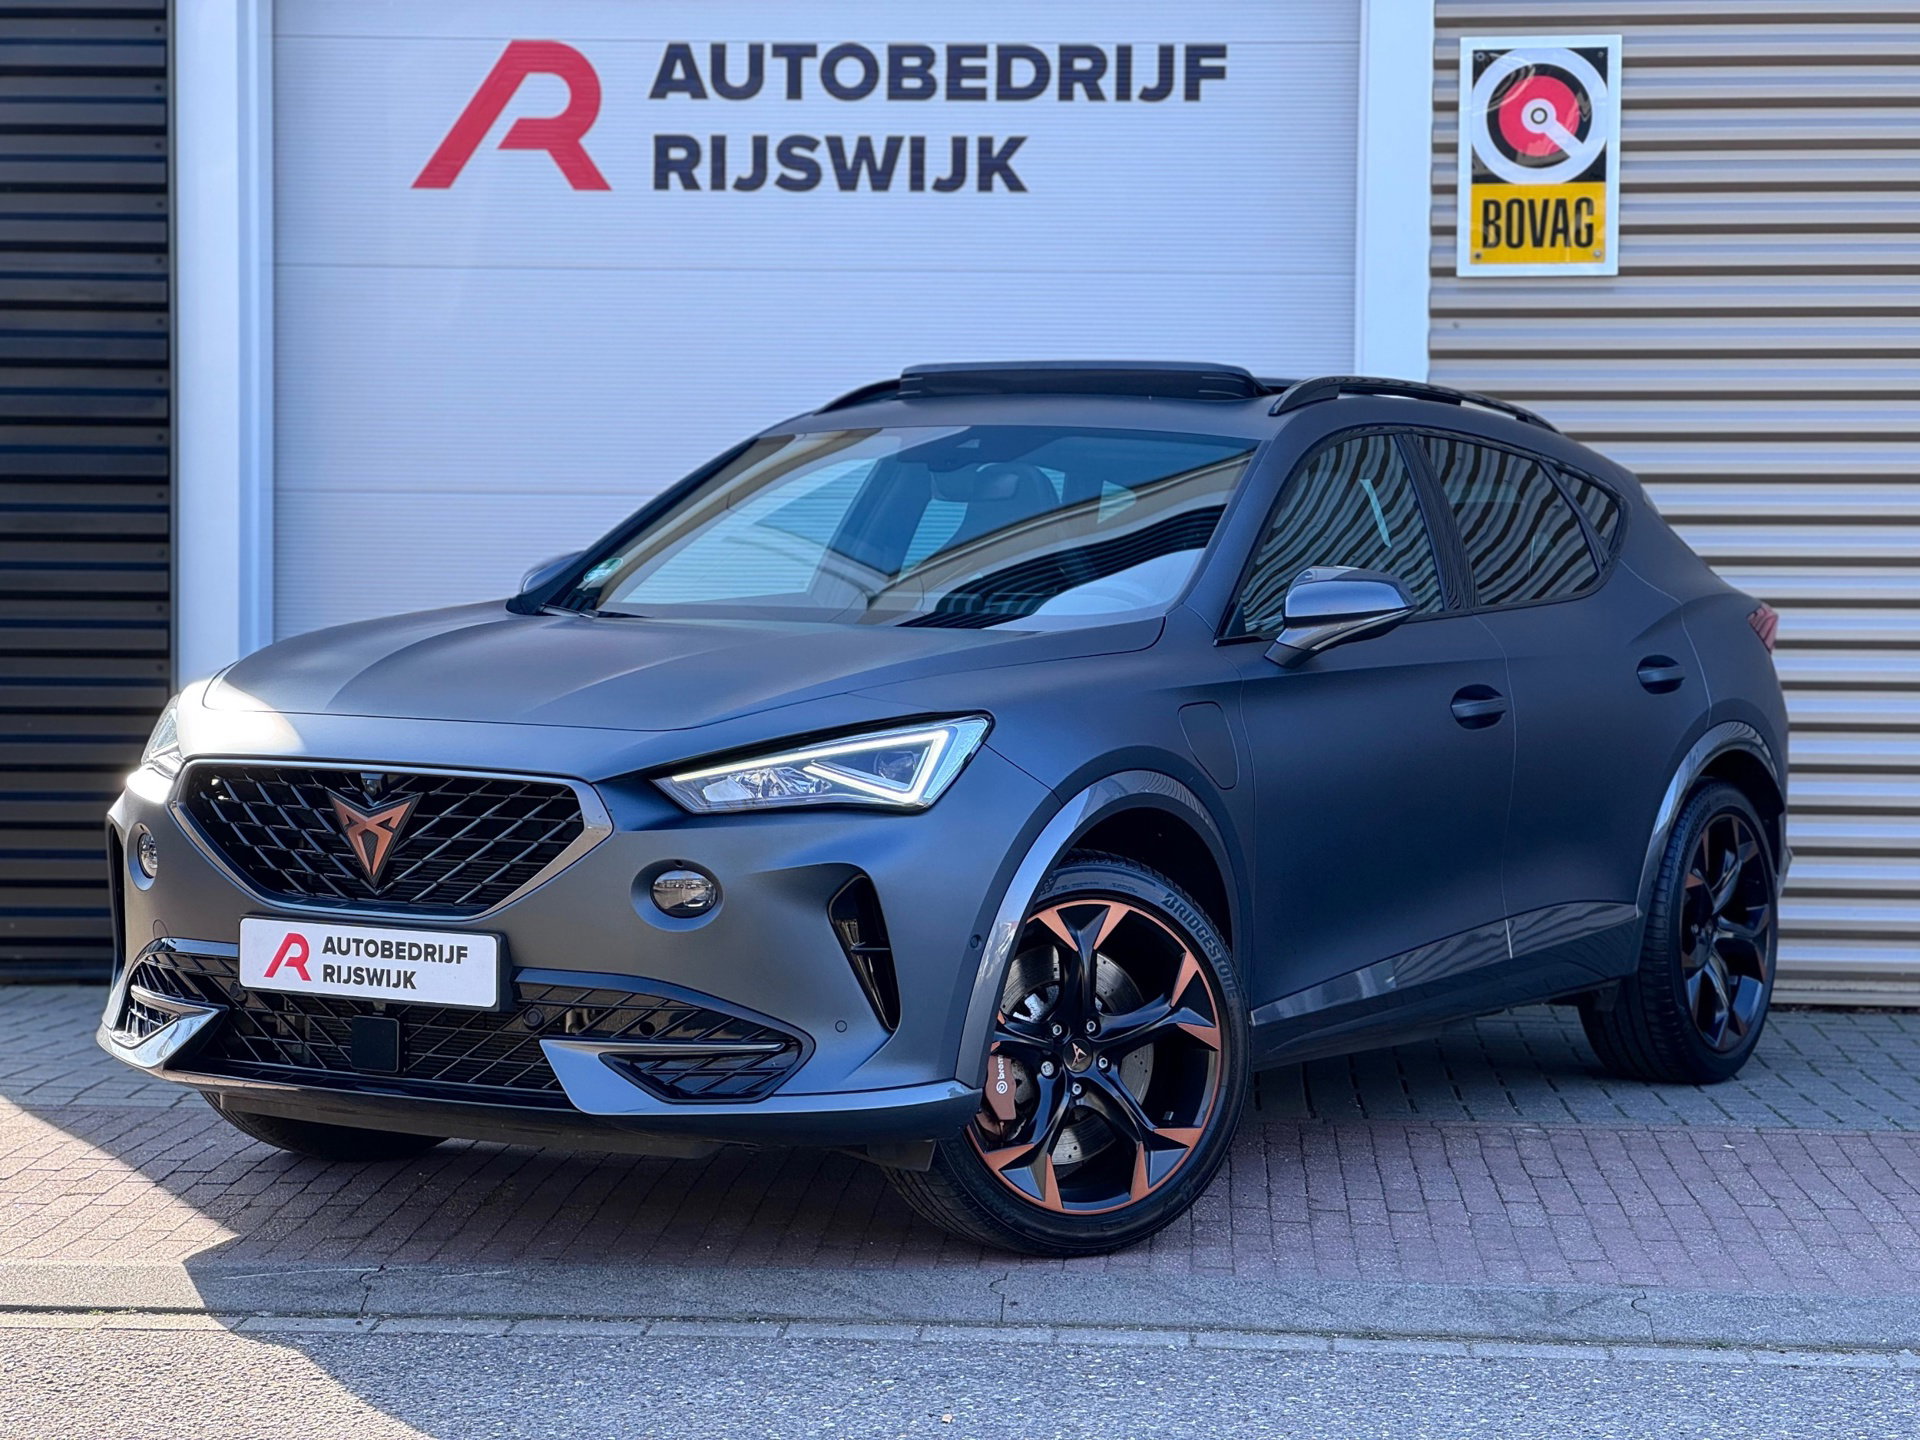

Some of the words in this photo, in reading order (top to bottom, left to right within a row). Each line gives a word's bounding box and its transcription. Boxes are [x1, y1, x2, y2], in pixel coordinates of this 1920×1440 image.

[648, 42, 1228, 103] AUTOBEDRIJF
[652, 134, 1029, 193] RIJSWIJK
[1482, 197, 1594, 249] BOVAG
[322, 936, 468, 965] AUTOBEDRIJF
[1160, 892, 1237, 999] BRIDGESTONE
[322, 964, 417, 990] RIJSWIJK
